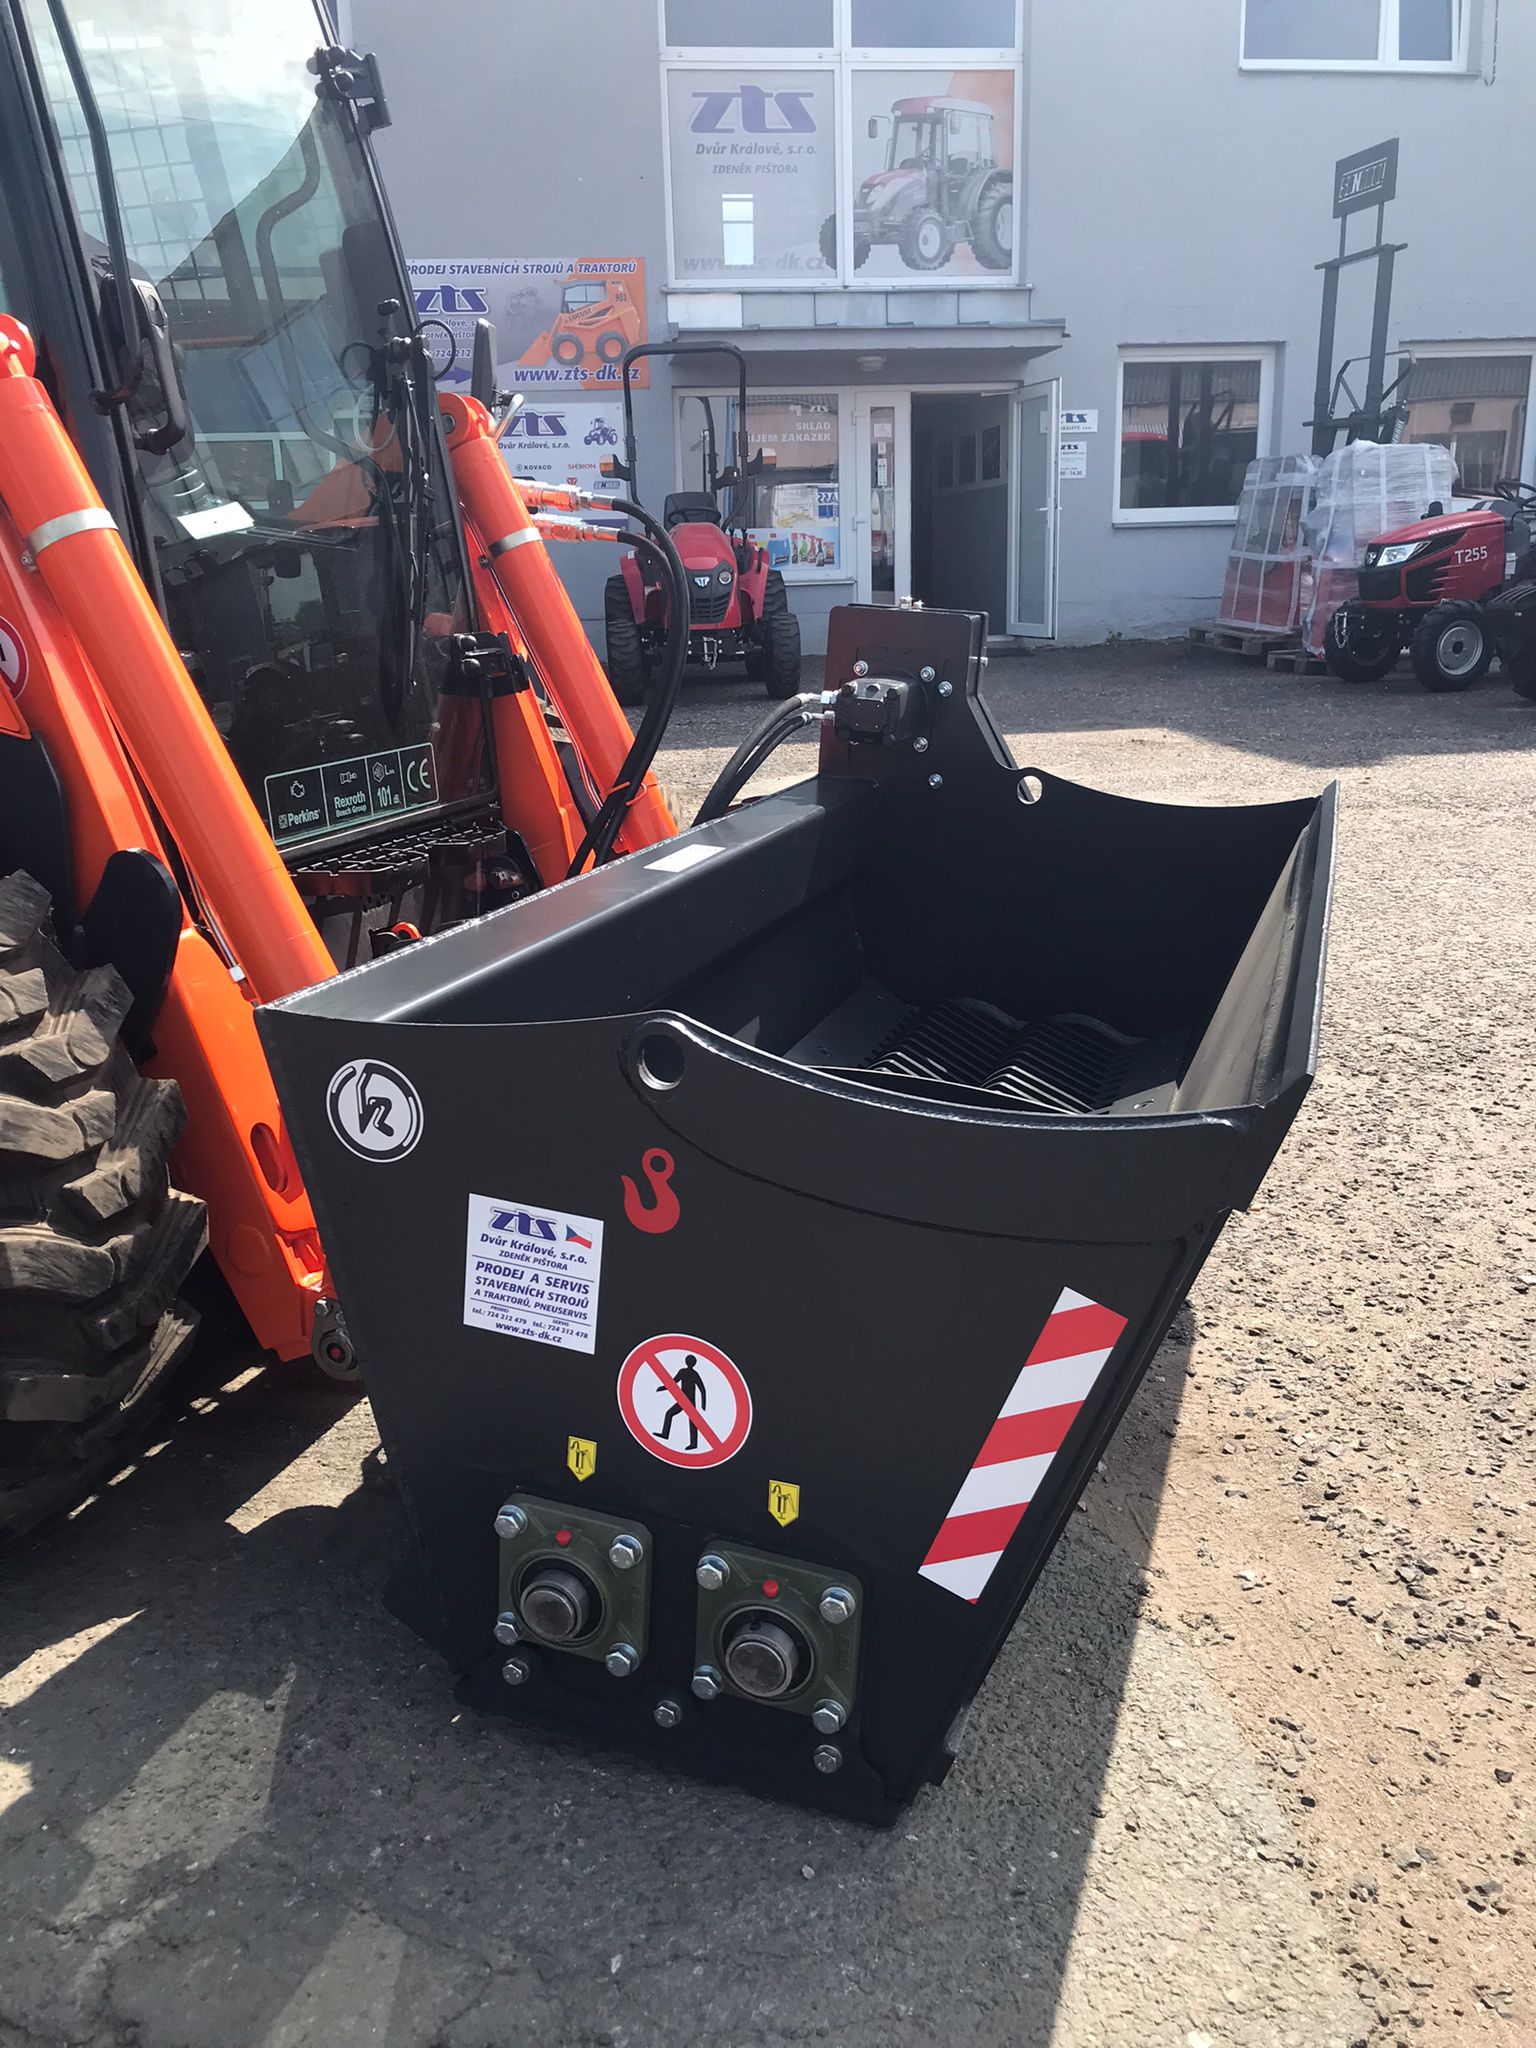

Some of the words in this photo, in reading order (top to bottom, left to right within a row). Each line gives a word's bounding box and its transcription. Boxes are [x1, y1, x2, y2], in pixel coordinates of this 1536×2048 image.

[690, 85, 817, 133] zts
[696, 142, 727, 155] Dvůr
[730, 142, 784, 156] Králové,
[787, 144, 818, 155] s.r.o.
[712, 162, 751, 174] ZDENĚK
[754, 162, 798, 174] PIŠTORA
[449, 262, 519, 274] STAVEBNÍCH
[523, 261, 563, 274] STROJŮ
[566, 263, 575, 273] A
[578, 260, 637, 273] TRAKTORŮ
[413, 285, 488, 313] zts
[795, 421, 831, 431] SKLAD
[517, 441, 550, 450] Králové,
[1454, 545, 1488, 564] T255
[334, 790, 366, 809] Rexroth
[376, 785, 393, 808] 101
[288, 808, 320, 826] Perkins
[336, 806, 351, 818] Bosch
[351, 804, 367, 816] Group
[490, 1209, 557, 1242] zts
[480, 1233, 508, 1247] Dvůr
[510, 1239, 557, 1259] Králové,
[560, 1252, 588, 1265] s.r.o.
[499, 1250, 531, 1263] ZDENĚK
[532, 1255, 568, 1271] PIŠTORA
[475, 1261, 525, 1280] PRODEJ
[530, 1273, 540, 1284] A
[545, 1276, 590, 1295] SERVIS
[475, 1275, 545, 1299] STAVEBNÍCH
[547, 1291, 589, 1309] STROJŮ
[484, 1290, 532, 1308] TRAKTORŮ,
[534, 1301, 588, 1320] PNEUSERVIS
[472, 1307, 486, 1316] tel.:
[487, 1310, 499, 1319] 724
[500, 1313, 513, 1322] 212
[514, 1316, 527, 1325] 479
[552, 1319, 570, 1327] SERVIS
[495, 1322, 562, 1343] www.zts-dk.cz
[532, 1320, 546, 1329] tel.:
[547, 1324, 560, 1333] 724
[561, 1327, 574, 1336] 212
[575, 1330, 588, 1339] 478
